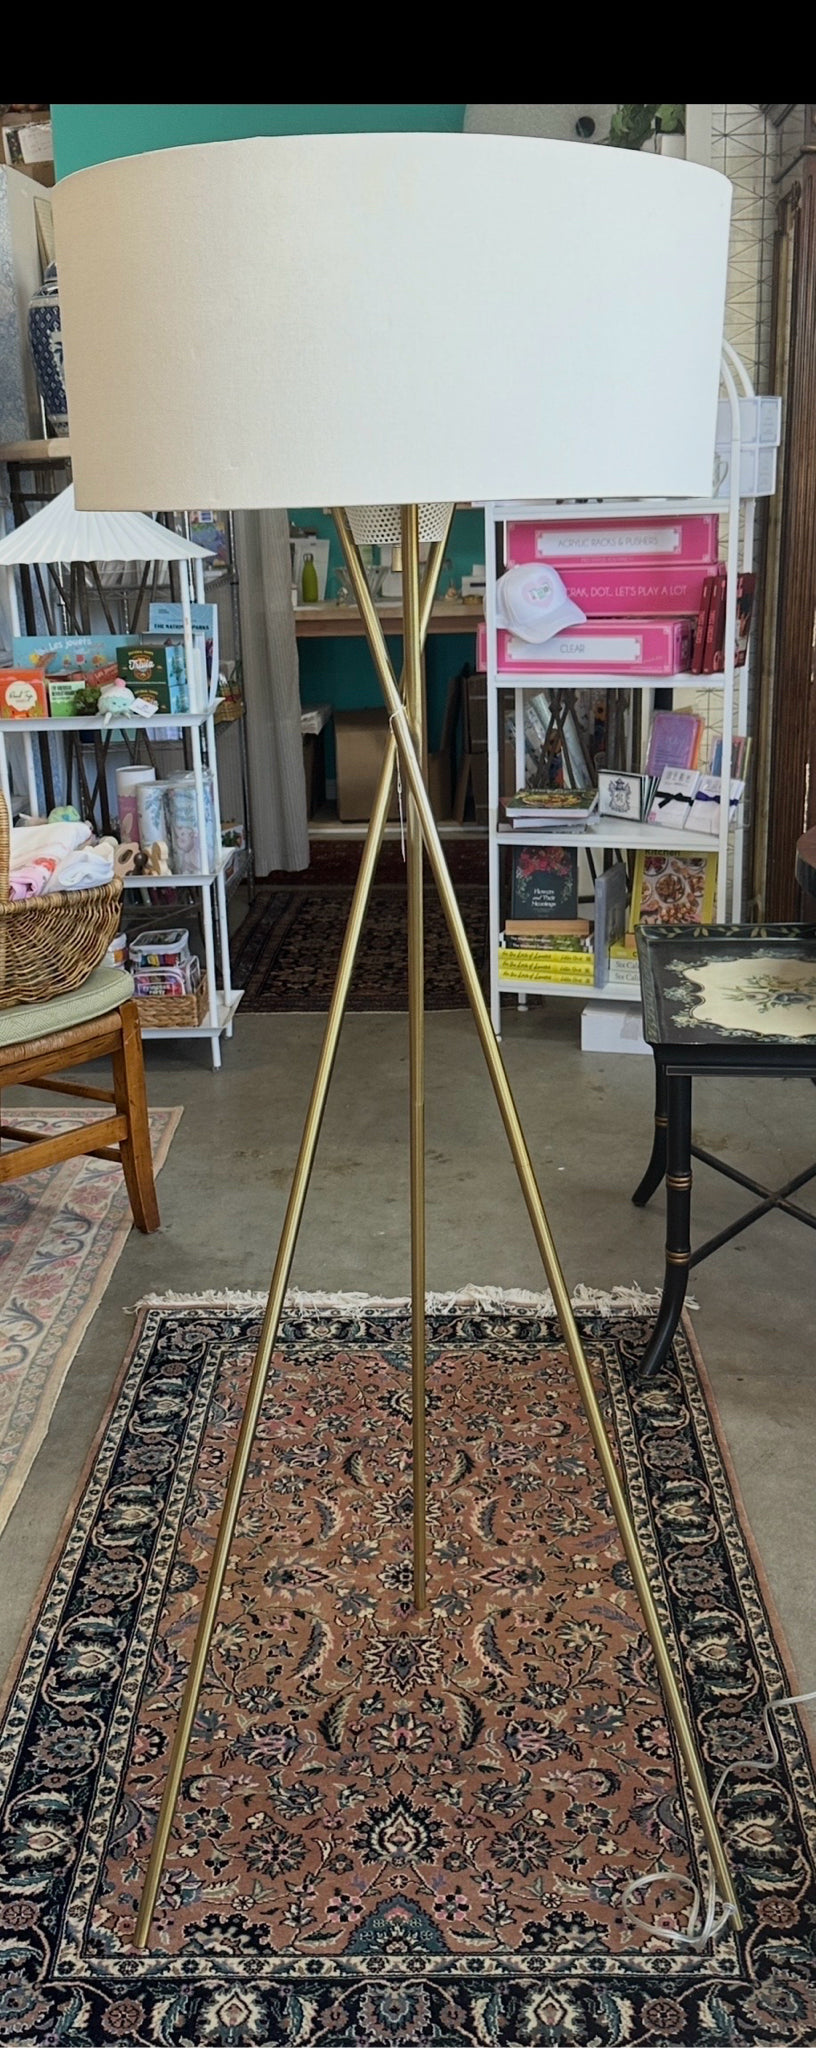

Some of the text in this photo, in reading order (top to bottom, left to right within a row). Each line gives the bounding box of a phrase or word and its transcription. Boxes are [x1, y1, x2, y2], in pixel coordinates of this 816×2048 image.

[559, 535, 658, 548] ACRYLIC RACKS & PUSHERS
[615, 585, 636, 597] LET'S
[638, 585, 658, 596] PLAY
[661, 586, 668, 596] A
[669, 584, 688, 596] LOT
[560, 643, 585, 654] CLEAR
